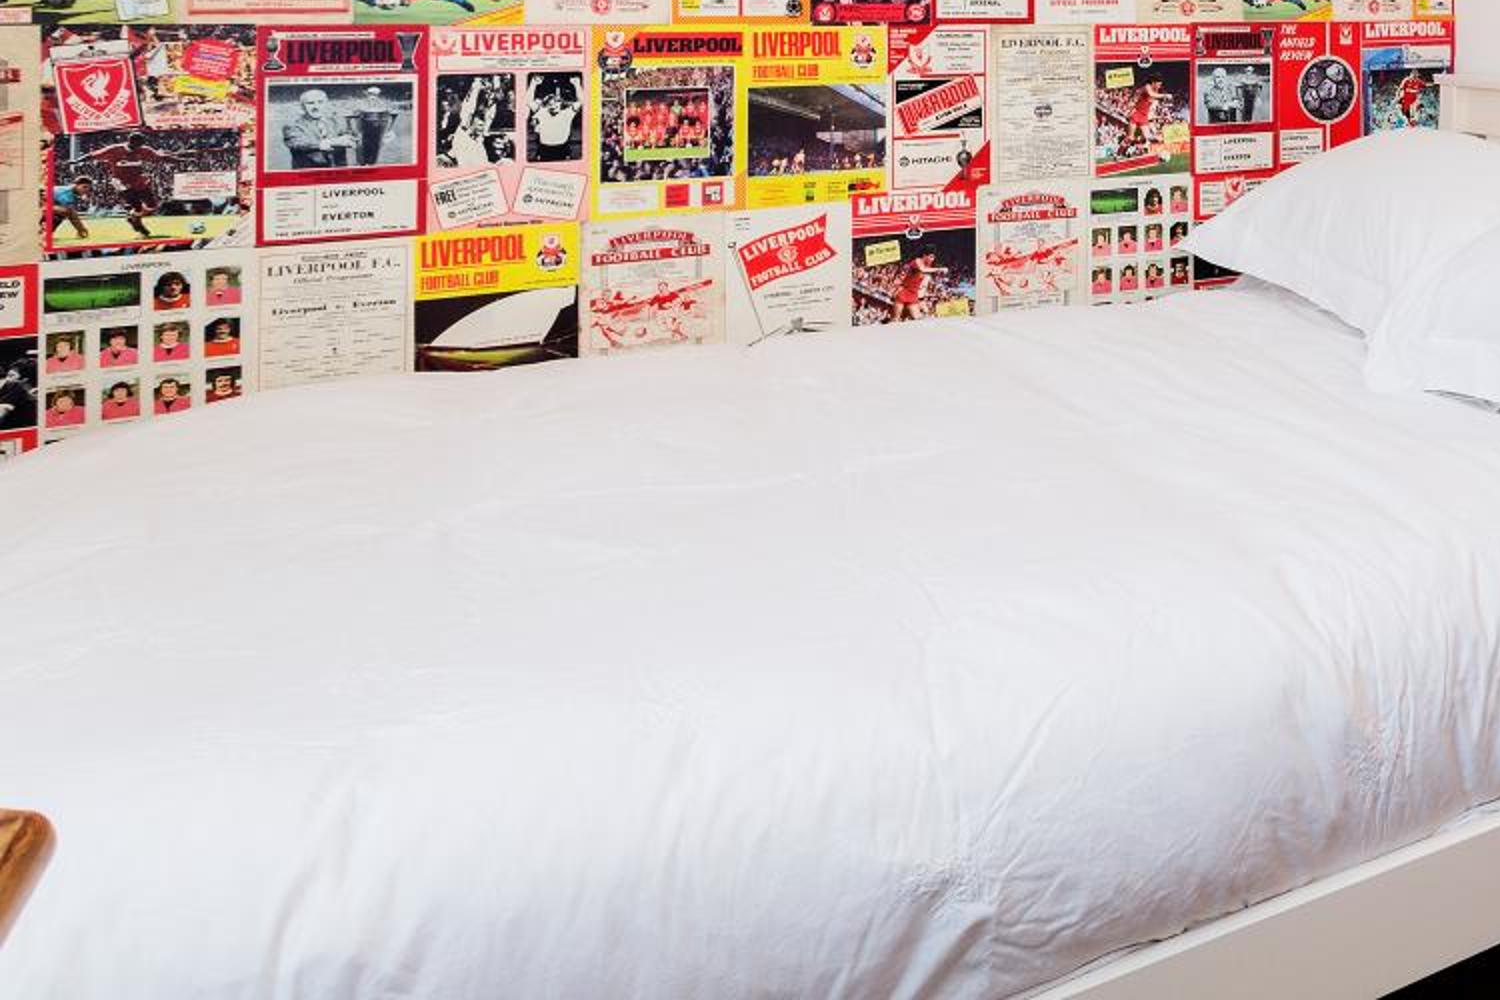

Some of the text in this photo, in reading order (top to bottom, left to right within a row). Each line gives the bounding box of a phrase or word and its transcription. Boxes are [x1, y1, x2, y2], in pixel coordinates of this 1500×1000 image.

[1099, 27, 1190, 43] LIVERPOOL
[1364, 23, 1445, 38] LIVERPOOL
[287, 39, 399, 64] LIVERPOOL
[461, 33, 583, 52] LIVERPOOL
[633, 37, 742, 53] LIVERPOOL
[753, 31, 841, 58] LIVERPOOL
[321, 188, 385, 199] LIVERPOOL
[858, 191, 970, 215] LIVERPOOL
[321, 212, 375, 221] EVERTON
[420, 233, 527, 268] LIVERPOOL
[743, 222, 824, 260] LIVERPOOL
[267, 258, 361, 277] LIVERPOOL
[751, 250, 832, 287] FOOTBALL CLUB
[420, 271, 499, 291] FOOTBALL CLUB
